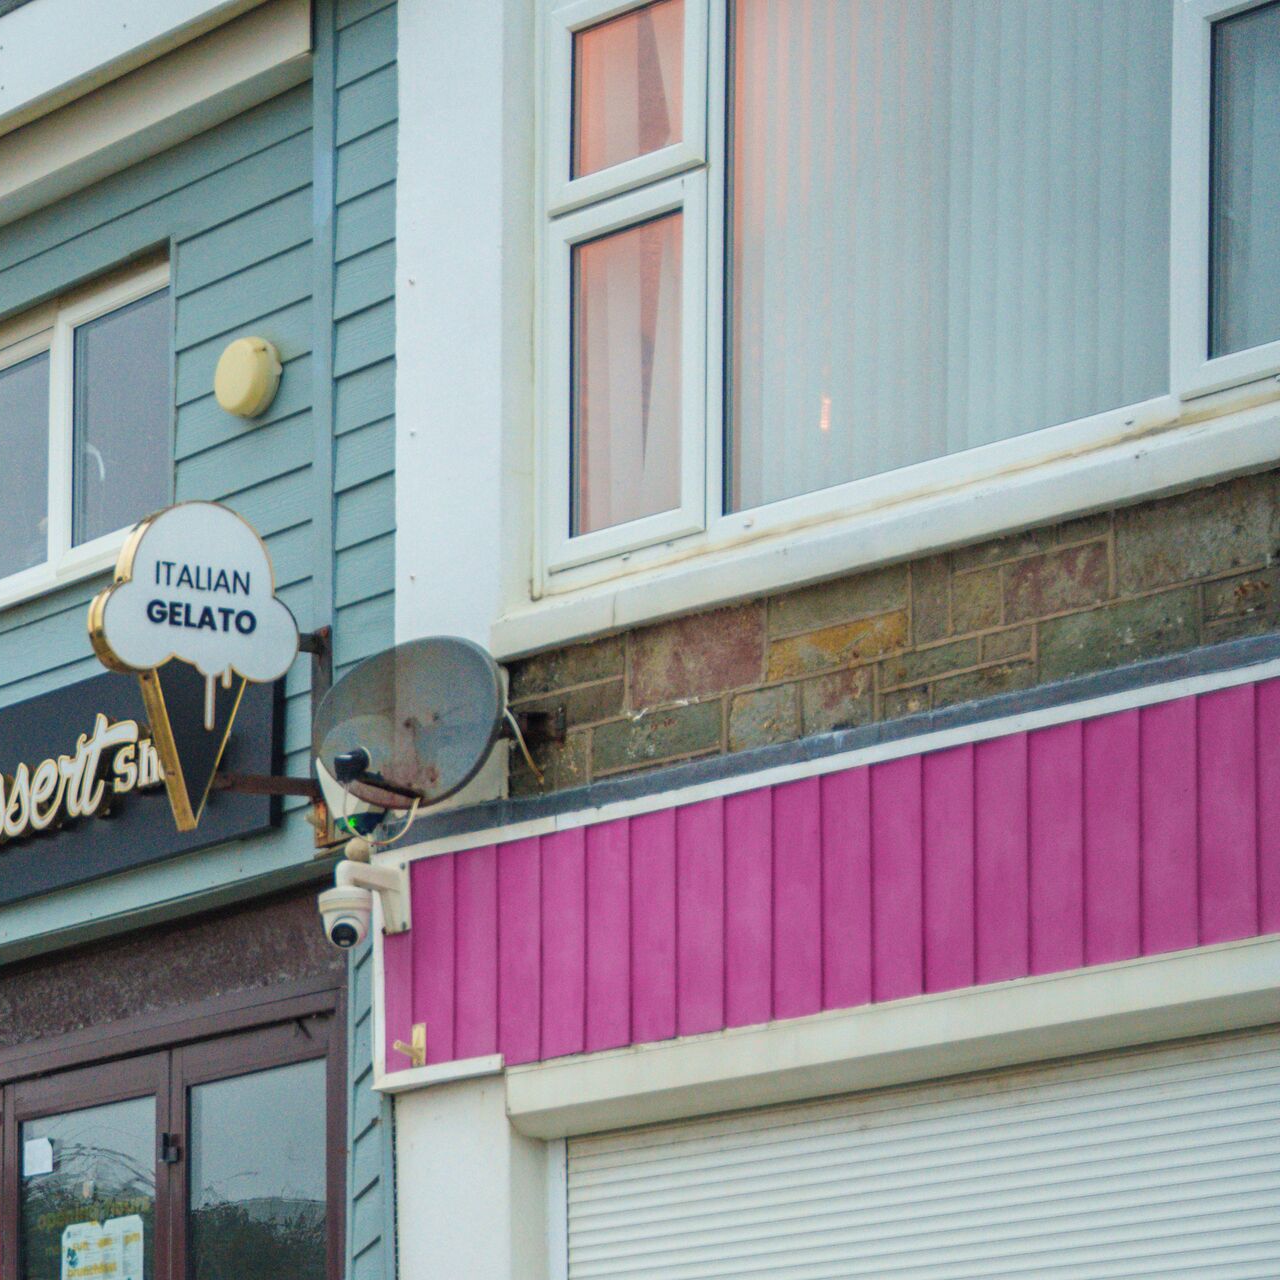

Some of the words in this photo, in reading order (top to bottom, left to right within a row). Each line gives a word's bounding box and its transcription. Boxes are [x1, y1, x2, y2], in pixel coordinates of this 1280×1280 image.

[155, 560, 251, 596] ITALIAN
[146, 598, 257, 635] GELATO
[112, 737, 166, 794] Sh
